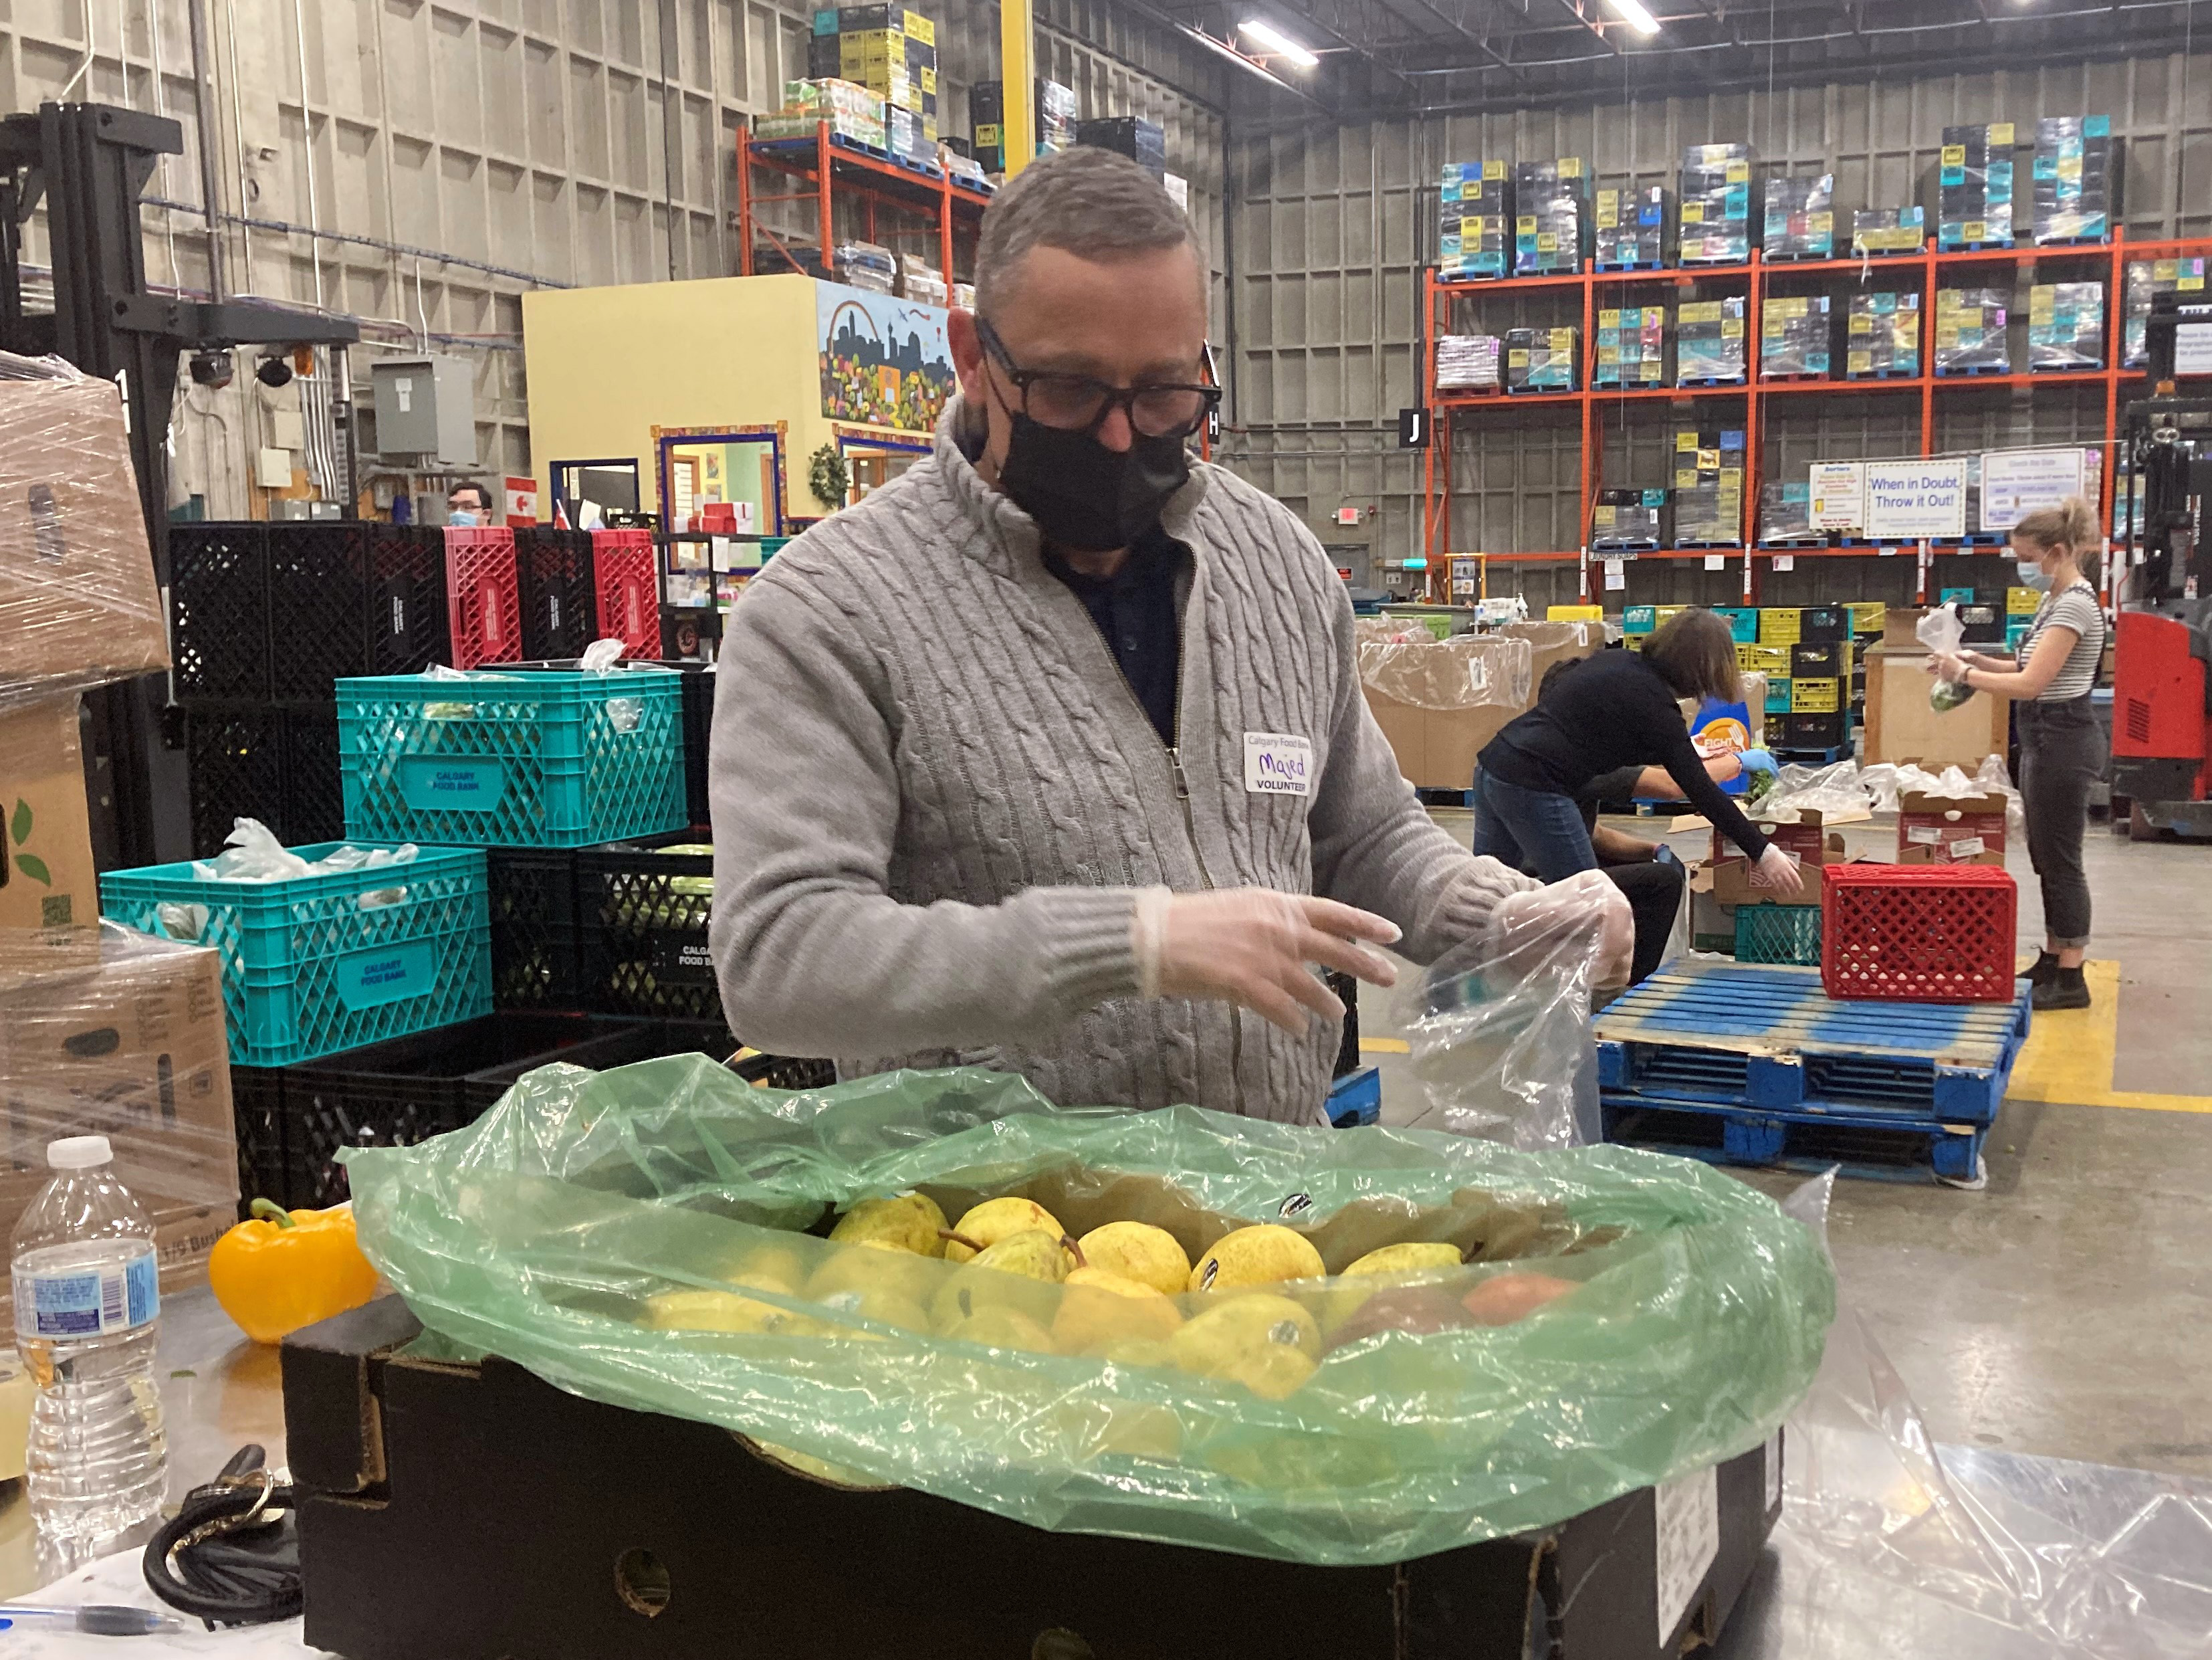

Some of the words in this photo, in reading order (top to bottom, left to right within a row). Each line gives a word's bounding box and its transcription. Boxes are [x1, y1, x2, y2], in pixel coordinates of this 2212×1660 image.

[1209, 411, 1218, 435] H
[1409, 413, 1420, 443] J
[1872, 478, 1904, 490] When
[1908, 477, 1918, 489] in
[1876, 496, 1913, 508] Throw
[1917, 495, 1924, 507] it
[1928, 494, 1953, 506] Out!
[1248, 736, 1279, 748] Calgary
[1280, 738, 1297, 748] Food
[1704, 738, 1733, 748] FIGHT
[437, 771, 475, 781] CALGARY
[1256, 779, 1306, 792] VOLUNTEER
[683, 945, 709, 956] CALG
[364, 959, 401, 975] CALGARY
[679, 955, 703, 966] FOOD
